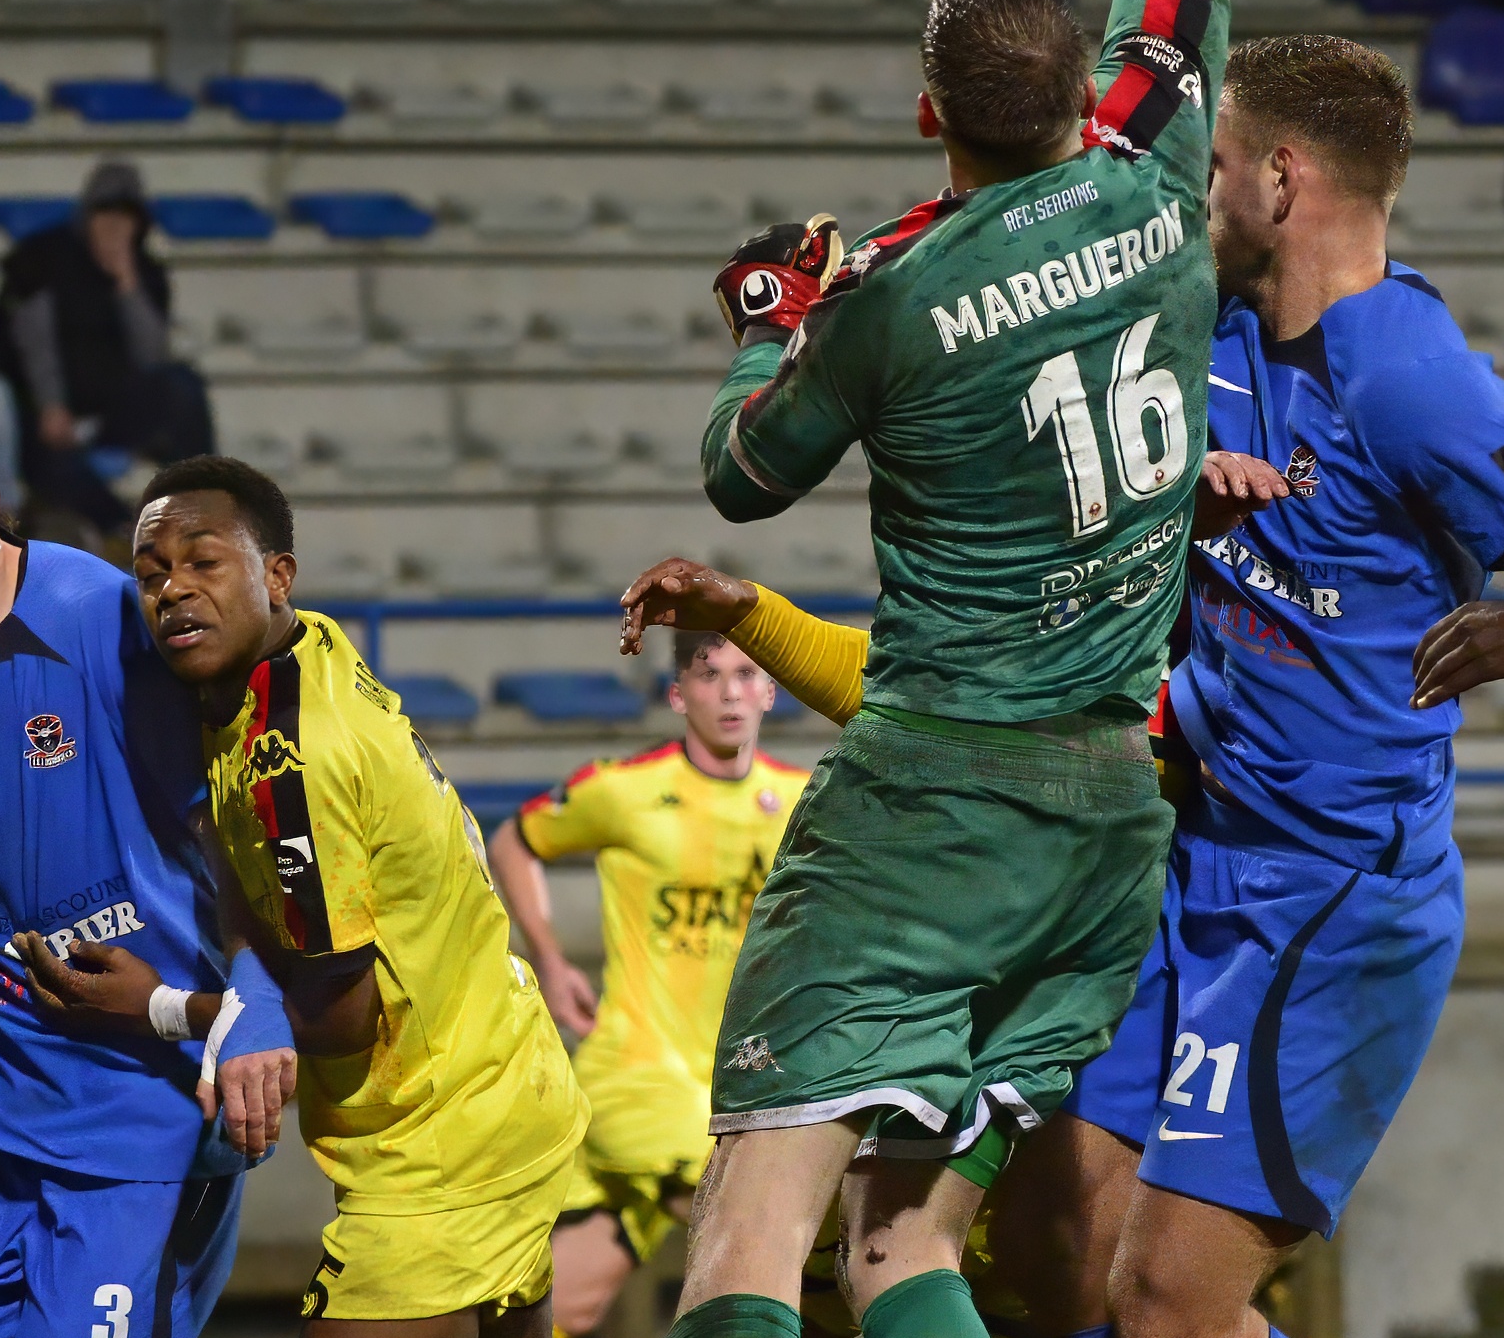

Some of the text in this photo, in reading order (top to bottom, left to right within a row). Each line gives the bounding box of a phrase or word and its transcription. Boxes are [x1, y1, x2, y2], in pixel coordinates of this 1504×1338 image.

[929, 198, 1184, 354] MARGUERON
[1019, 312, 1188, 539] 16
[1163, 1031, 1241, 1115] 21
